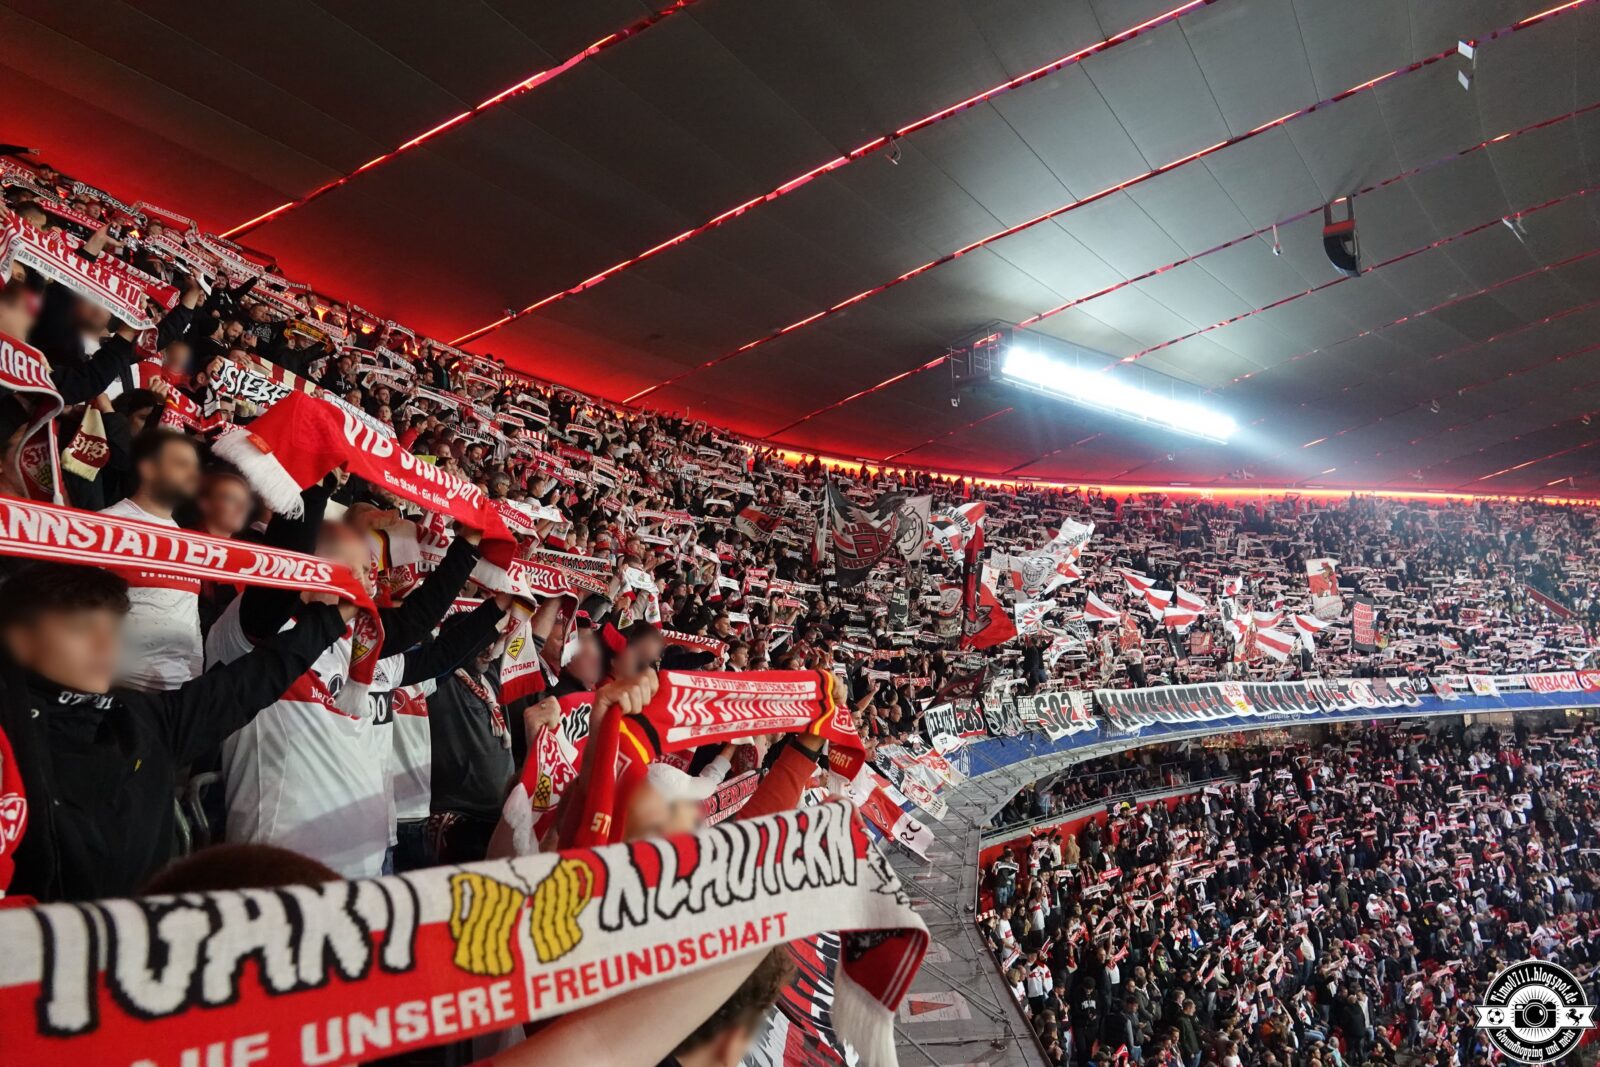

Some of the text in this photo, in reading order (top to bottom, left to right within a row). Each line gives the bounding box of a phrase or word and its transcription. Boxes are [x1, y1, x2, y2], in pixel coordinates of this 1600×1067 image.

[62, 203, 104, 229] Stuttgar
[239, 552, 333, 584] JUNGS
[1527, 673, 1578, 691] URBACH
[1242, 684, 1318, 713] KURVE
[302, 982, 516, 1066] UNSERE
[531, 911, 789, 1011] FREUNDSCHAFT
